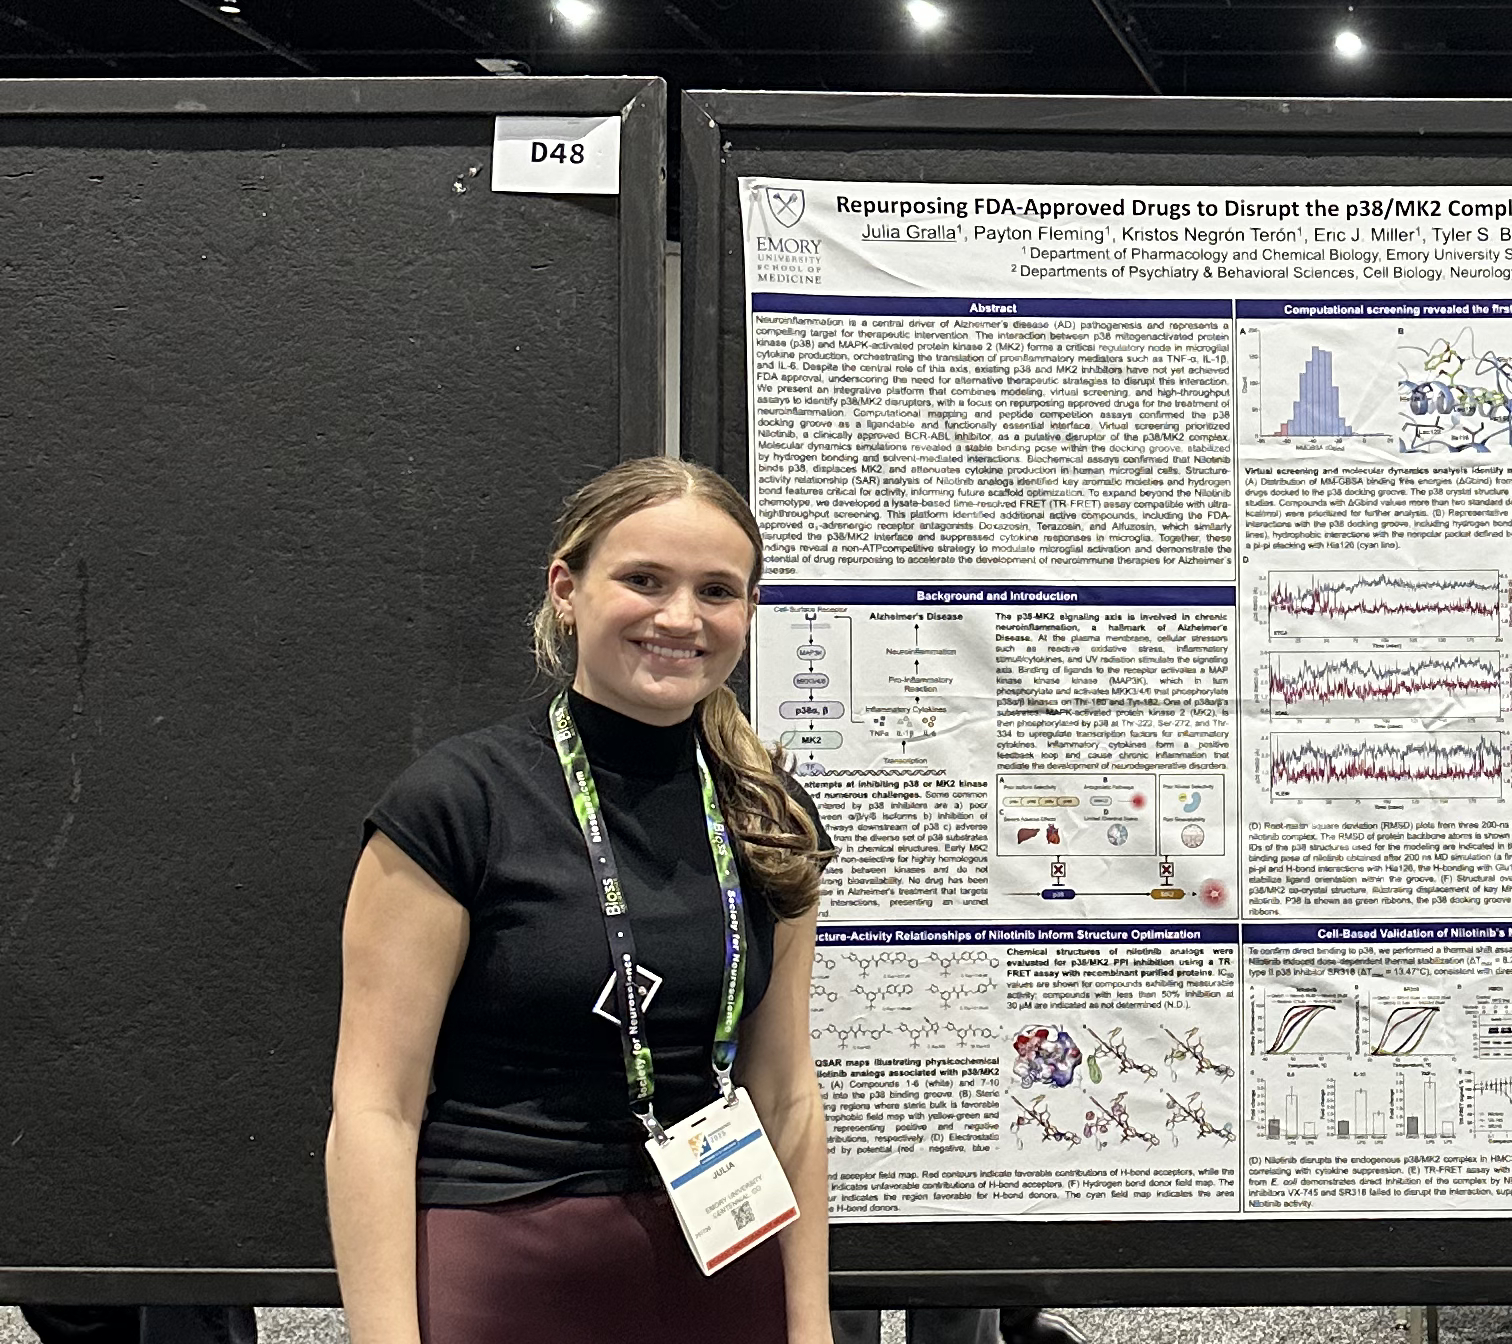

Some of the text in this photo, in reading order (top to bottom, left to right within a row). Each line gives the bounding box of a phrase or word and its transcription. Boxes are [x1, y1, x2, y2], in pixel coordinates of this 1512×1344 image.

[530, 141, 585, 165] D48
[836, 195, 969, 219] Repurposing
[974, 198, 1125, 220] FDA-Approved
[1132, 199, 1191, 221] Drugs
[1196, 200, 1218, 217] to
[1225, 199, 1300, 221] Disrupt
[1304, 198, 1340, 217] the
[1346, 197, 1442, 221] p38/MK2
[861, 223, 900, 243] Julia
[974, 225, 1032, 244] Payton
[1122, 226, 1180, 242] Kristos
[1314, 227, 1347, 242] Eric
[1431, 227, 1473, 246] Tyler
[757, 237, 822, 254] EMORY
[757, 254, 821, 264] UNIVERSITY
[1030, 246, 1110, 262] Department
[1113, 247, 1128, 260] of
[1131, 247, 1229, 264] Pharmacology
[1232, 248, 1258, 261] and
[1262, 248, 1325, 261] Chemical
[1386, 248, 1430, 264] Emory
[1434, 248, 1500, 264] University
[757, 264, 804, 273] SCHOOL
[1020, 264, 1108, 280] Departments
[1111, 265, 1125, 278] of
[1129, 265, 1199, 282] Psychiatry
[1202, 265, 1214, 279] &
[1217, 266, 1289, 279] Behavioral
[1293, 266, 1359, 281] Sciences,
[1362, 266, 1389, 279] Cell
[757, 273, 822, 284] MEDICINE
[970, 302, 1017, 314] Abstract
[1284, 304, 1363, 317] Computational
[1367, 304, 1420, 317] screening
[1423, 303, 1469, 315] revealed
[1472, 304, 1490, 314] the
[917, 590, 1078, 603] Background and Introduction
[926, 612, 963, 621] Disease
[801, 736, 822, 744] MK2
[895, 930, 972, 943] Relationships
[974, 929, 987, 941] of
[988, 929, 1036, 940] Nilotinib
[1037, 929, 1074, 940] Inform
[1076, 929, 1129, 940] Structure
[1130, 929, 1201, 942] Optimization
[1317, 928, 1378, 939] Cell-Based
[1380, 928, 1435, 939] Validation
[1437, 927, 1449, 938] of
[724, 889, 741, 1033] Society for Neuroscience
[622, 953, 639, 1035] Neuroscience
[634, 1058, 648, 1099] Society
[712, 1161, 736, 1180] JULIA
